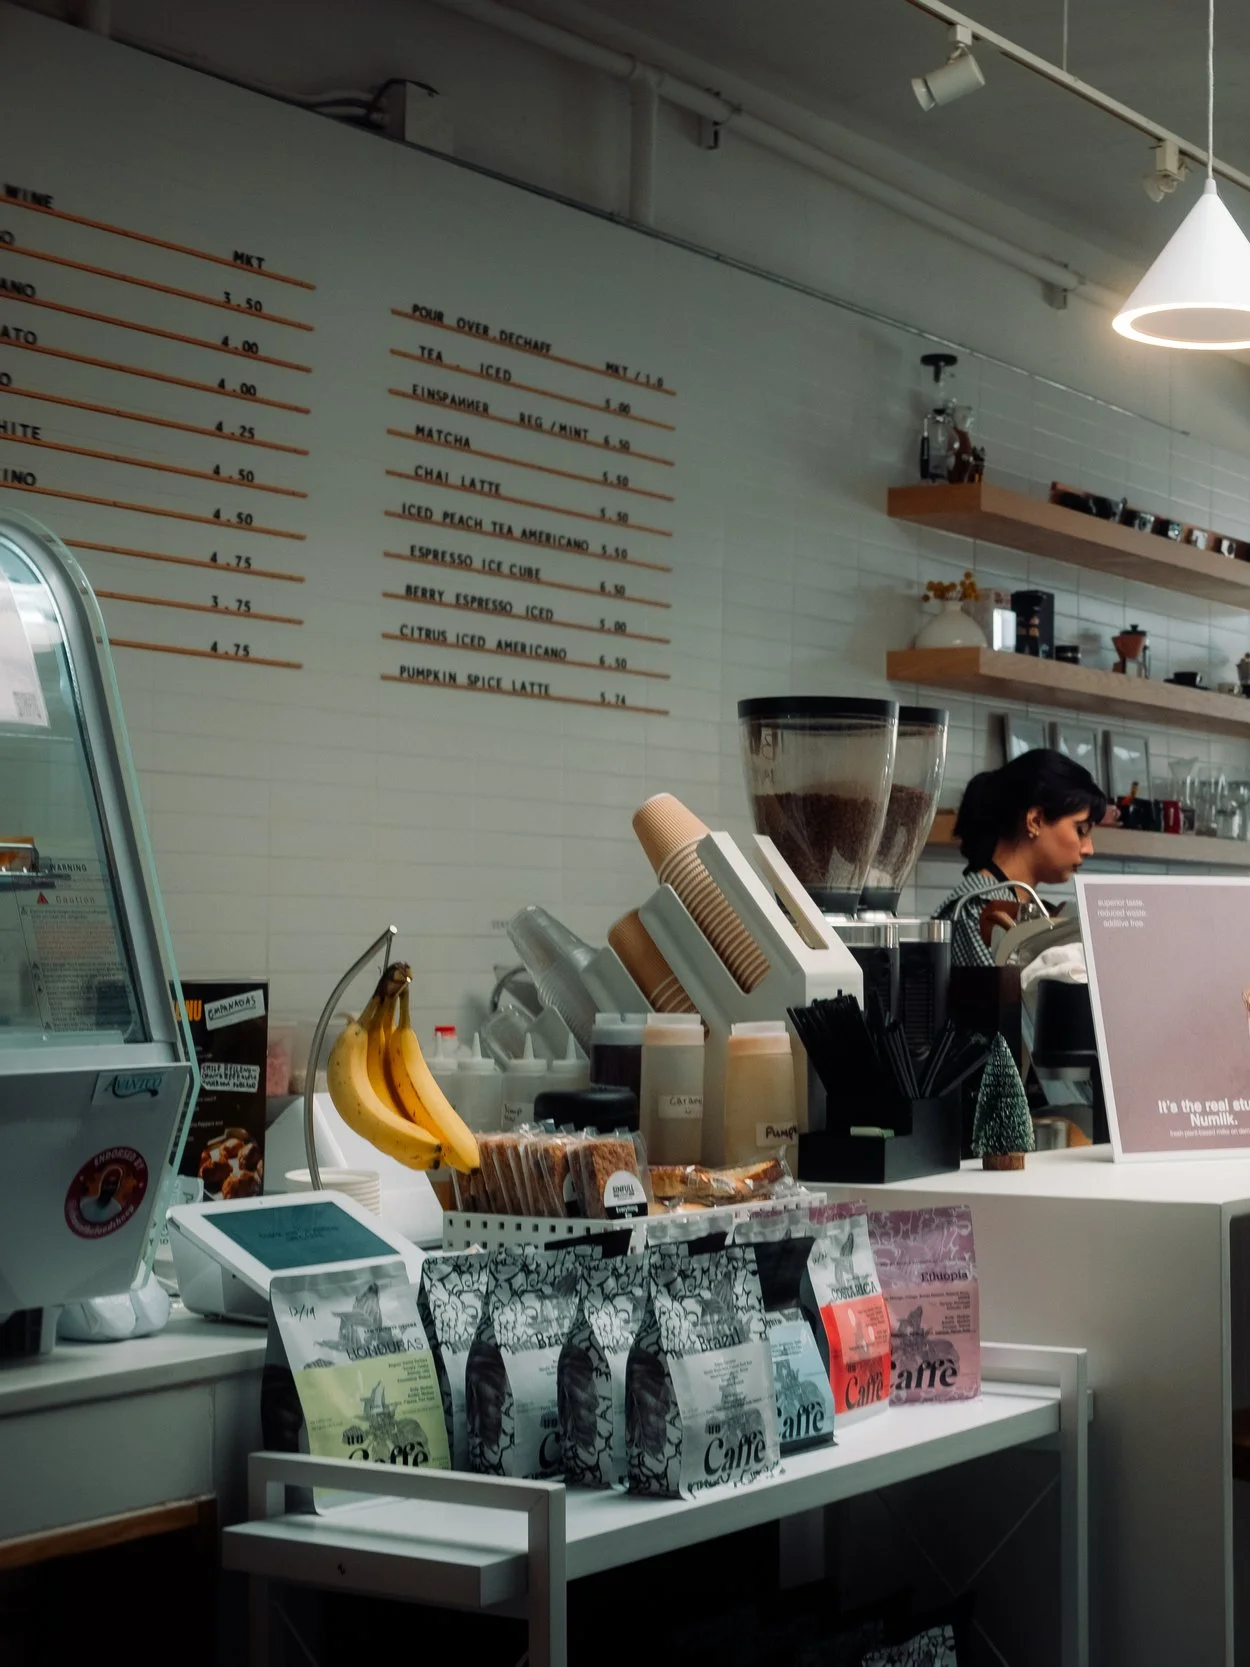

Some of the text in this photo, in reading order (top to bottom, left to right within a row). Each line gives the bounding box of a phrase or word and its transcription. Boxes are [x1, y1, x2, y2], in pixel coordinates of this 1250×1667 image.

[4, 183, 266, 269] WINE MKT
[223, 291, 263, 312] 3.50
[221, 336, 260, 355] 4.00
[412, 304, 445, 324] POUR
[605, 361, 628, 378] MKT
[418, 345, 443, 364] TEA
[480, 362, 512, 383] ICED
[217, 378, 257, 397] 4.00
[214, 420, 256, 440] 4.25
[519, 411, 543, 429] REG
[603, 435, 631, 452] 6.50
[415, 424, 629, 488] MATCHA 5.50
[212, 464, 255, 484] 4.50
[414, 464, 629, 524] CHAI LATTE 5.50
[212, 508, 254, 526] 4.50
[402, 502, 628, 560] ICED PEACH TEA AMERICANO 5.50
[210, 552, 252, 570] 4.75
[410, 545, 626, 597] ESPRESSO ICE CUBE 6.50
[210, 595, 252, 613] 3.75
[405, 584, 627, 634] BERRY ESPRESSO ICED 5.00
[210, 640, 250, 657] 4.75
[399, 623, 628, 670] CITRUS ICED AMERICANO 6.50
[399, 664, 457, 686] PUMPKIN
[467, 673, 502, 690] SPICE
[512, 679, 551, 697] LATTE
[50, 863, 87, 873] WARNING
[1158, 1100, 1178, 1114] It's
[1180, 1099, 1202, 1112] the
[1204, 1098, 1229, 1112] real
[1190, 1111, 1239, 1127] Numilk.
[921, 1270, 969, 1284] Ethiopia
[345, 1336, 425, 1362] HONDURAS
[697, 1326, 742, 1352] Brazil
[889, 1358, 957, 1391] affè
[704, 1428, 766, 1476] Caffè
